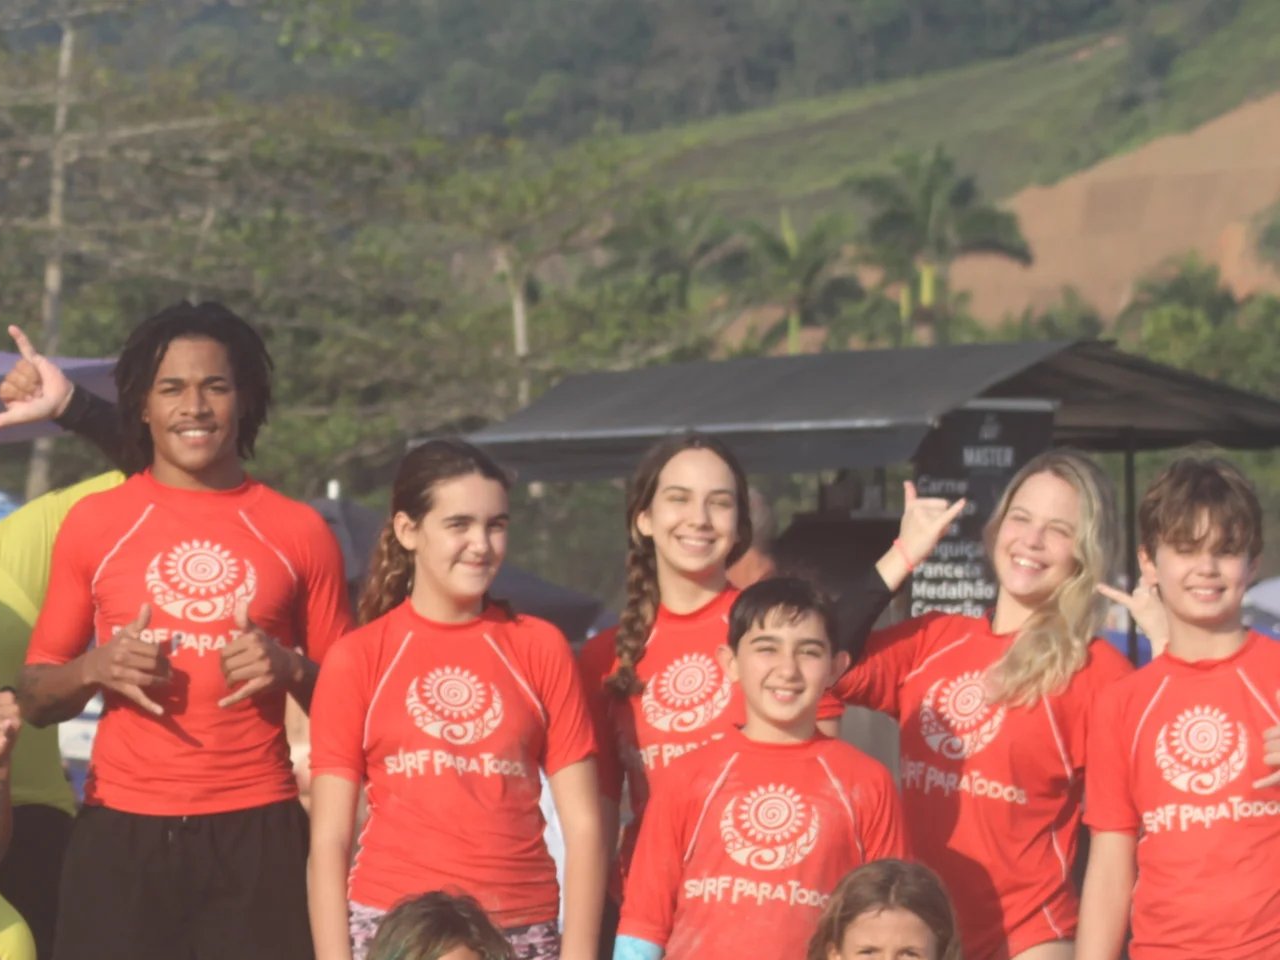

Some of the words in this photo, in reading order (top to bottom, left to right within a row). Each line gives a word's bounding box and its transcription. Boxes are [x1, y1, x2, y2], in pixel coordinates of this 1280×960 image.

[911, 580, 994, 600] Medalhão
[171, 631, 227, 657] PARA
[384, 747, 431, 778] SURF
[432, 749, 481, 776] PARA
[924, 766, 971, 797] PARA
[970, 769, 1027, 805] TODOS
[1179, 804, 1231, 832] PARA
[1228, 796, 1280, 822] TODO
[684, 872, 732, 903] SURF
[731, 878, 787, 906] PARA
